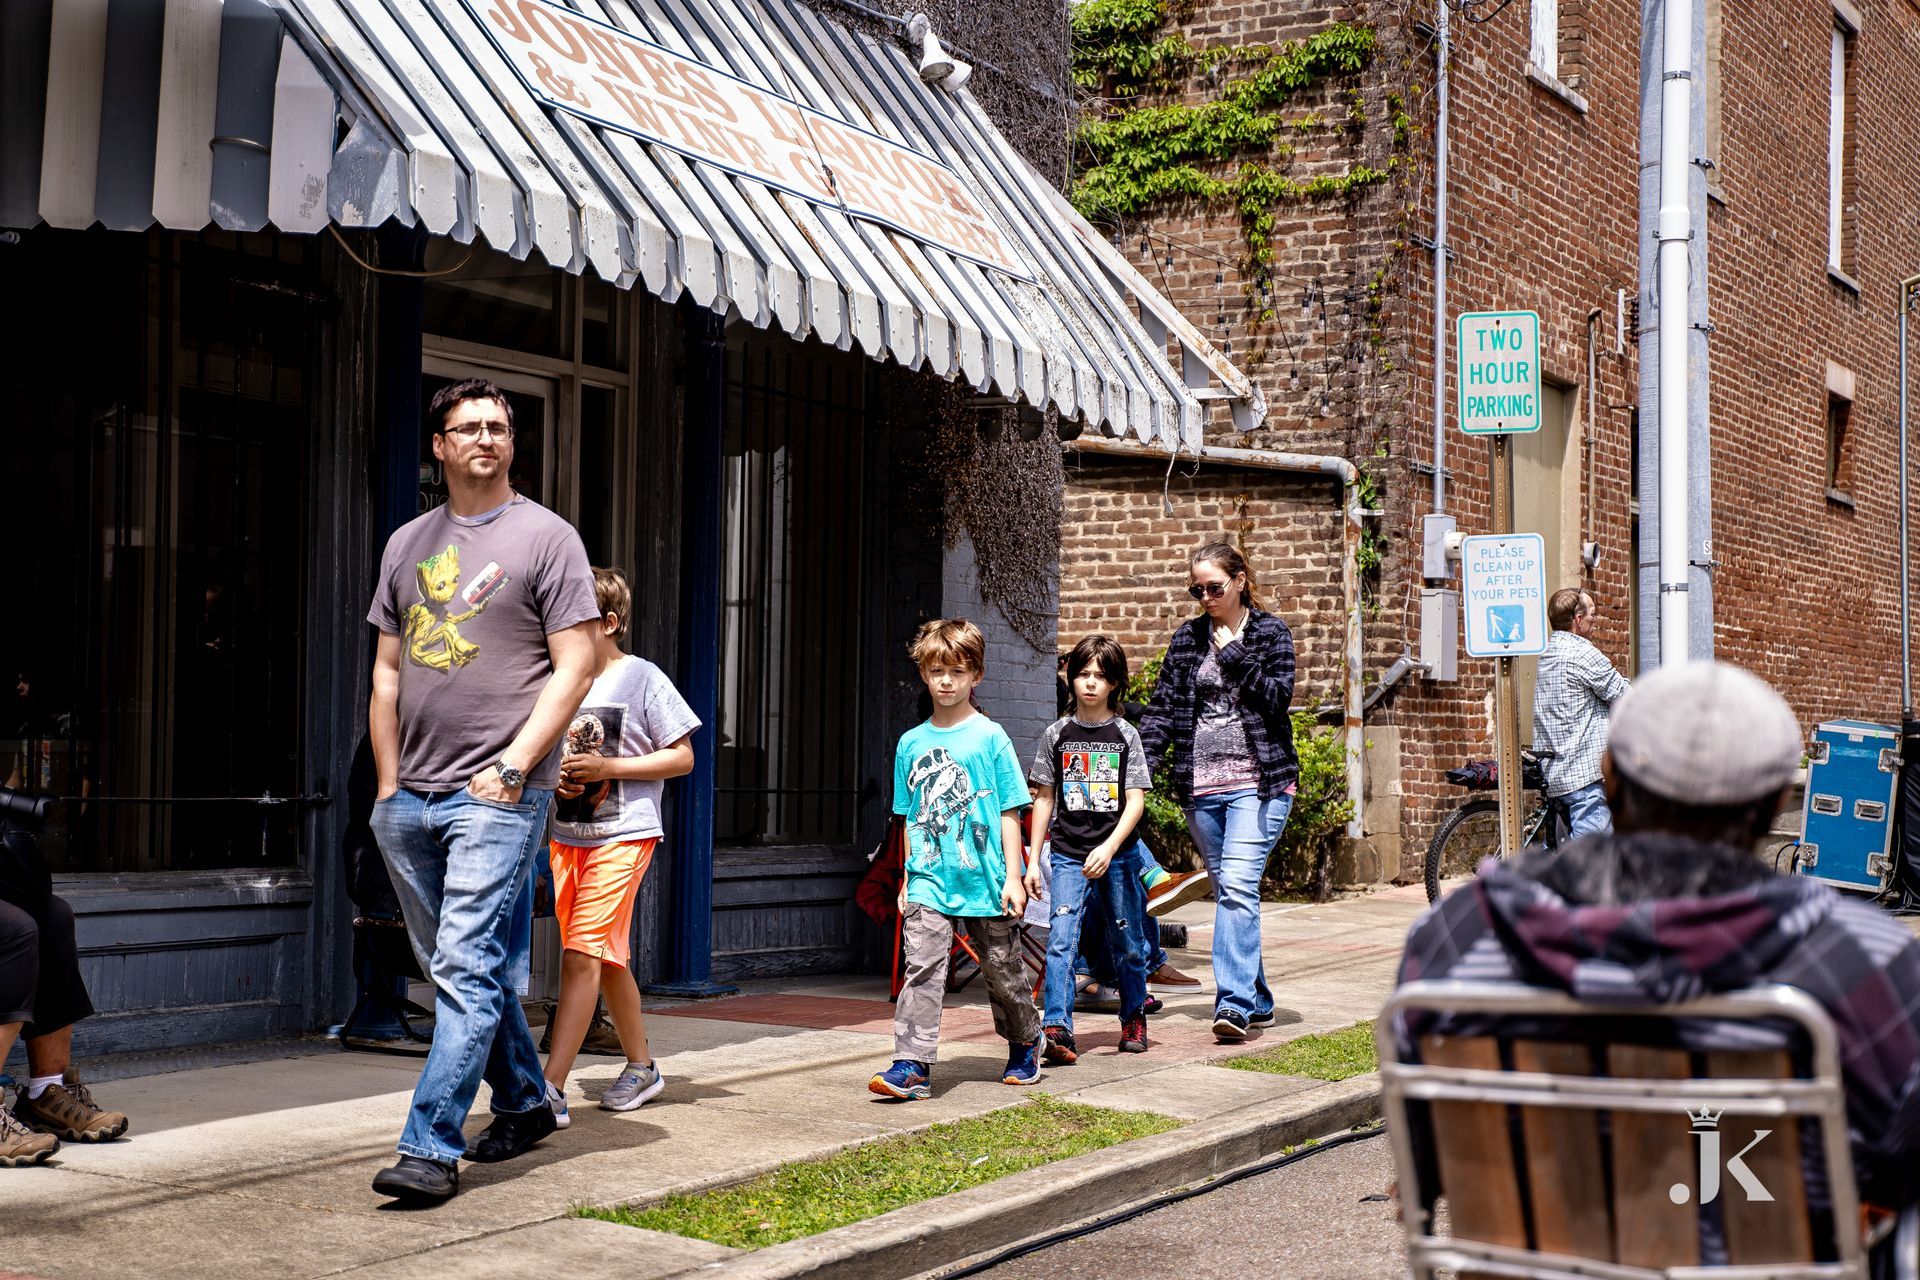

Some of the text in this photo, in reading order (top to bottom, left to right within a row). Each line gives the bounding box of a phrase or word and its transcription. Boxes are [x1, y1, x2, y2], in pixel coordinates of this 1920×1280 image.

[488, 0, 985, 221] JONES LIQUOR
[528, 51, 1017, 269] & WINE GALLERY
[1476, 328, 1523, 351] TWO
[1470, 361, 1529, 385] HOUR
[1467, 394, 1533, 418] PARKING
[1481, 547, 1525, 559] PLEASE
[1473, 560, 1534, 573] CLEAN UP
[1486, 574, 1523, 586] AFTER
[1472, 587, 1539, 600] YOUR PETS
[1059, 742, 1125, 752] STAR WARS
